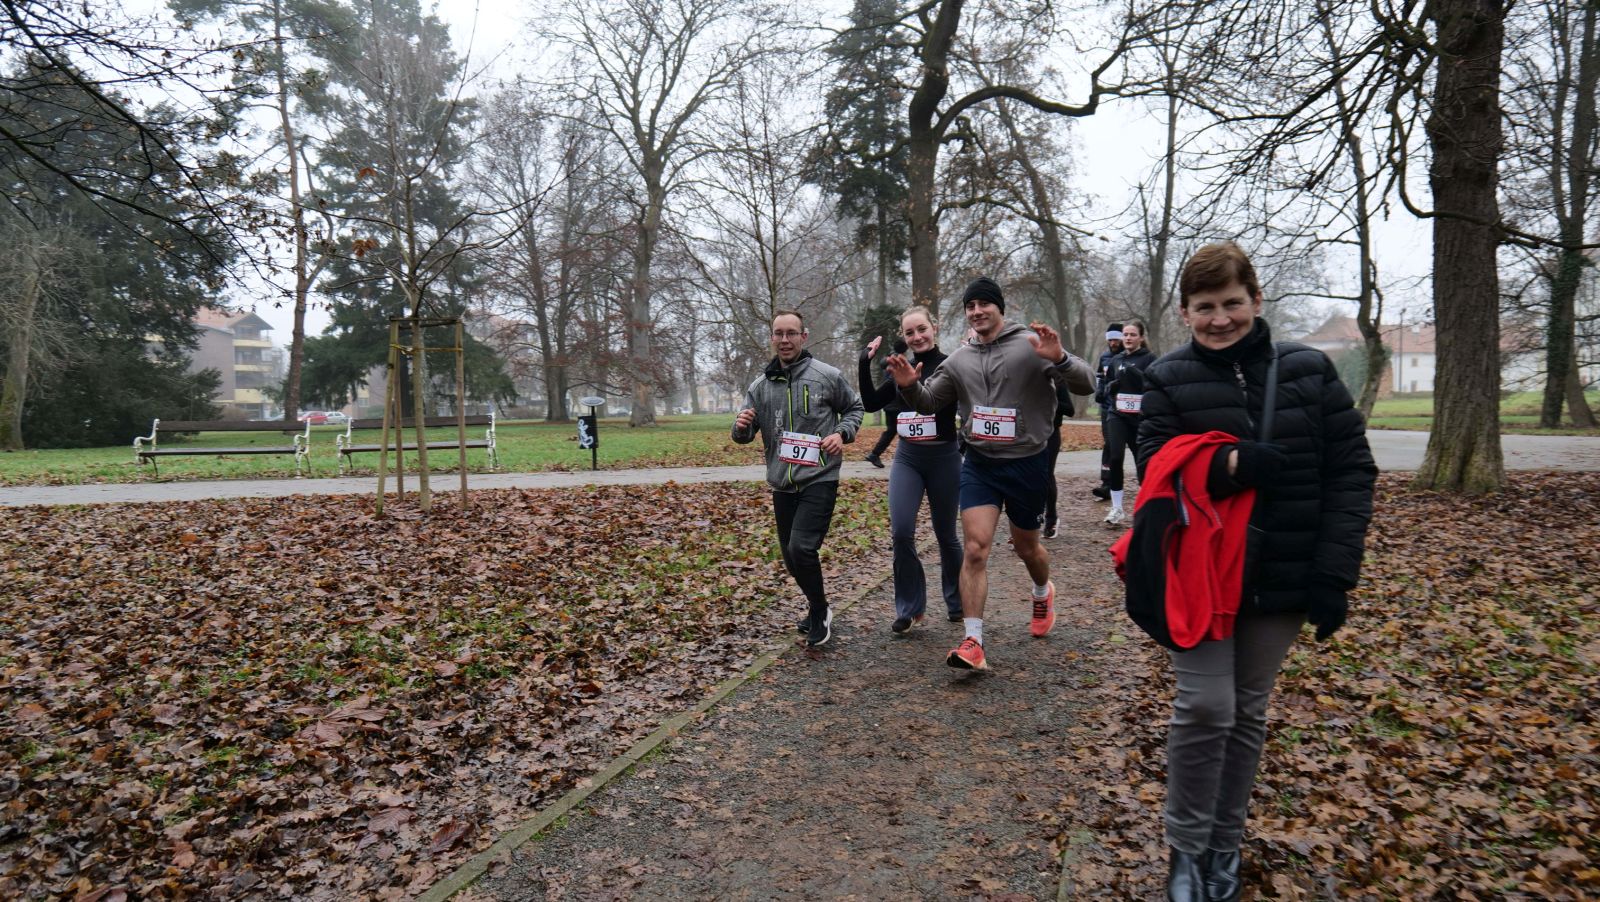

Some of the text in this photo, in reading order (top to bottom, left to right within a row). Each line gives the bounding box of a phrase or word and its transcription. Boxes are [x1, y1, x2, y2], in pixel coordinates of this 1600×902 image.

[909, 424, 923, 436] 95
[984, 421, 1000, 435] 96
[792, 446, 808, 459] 97
